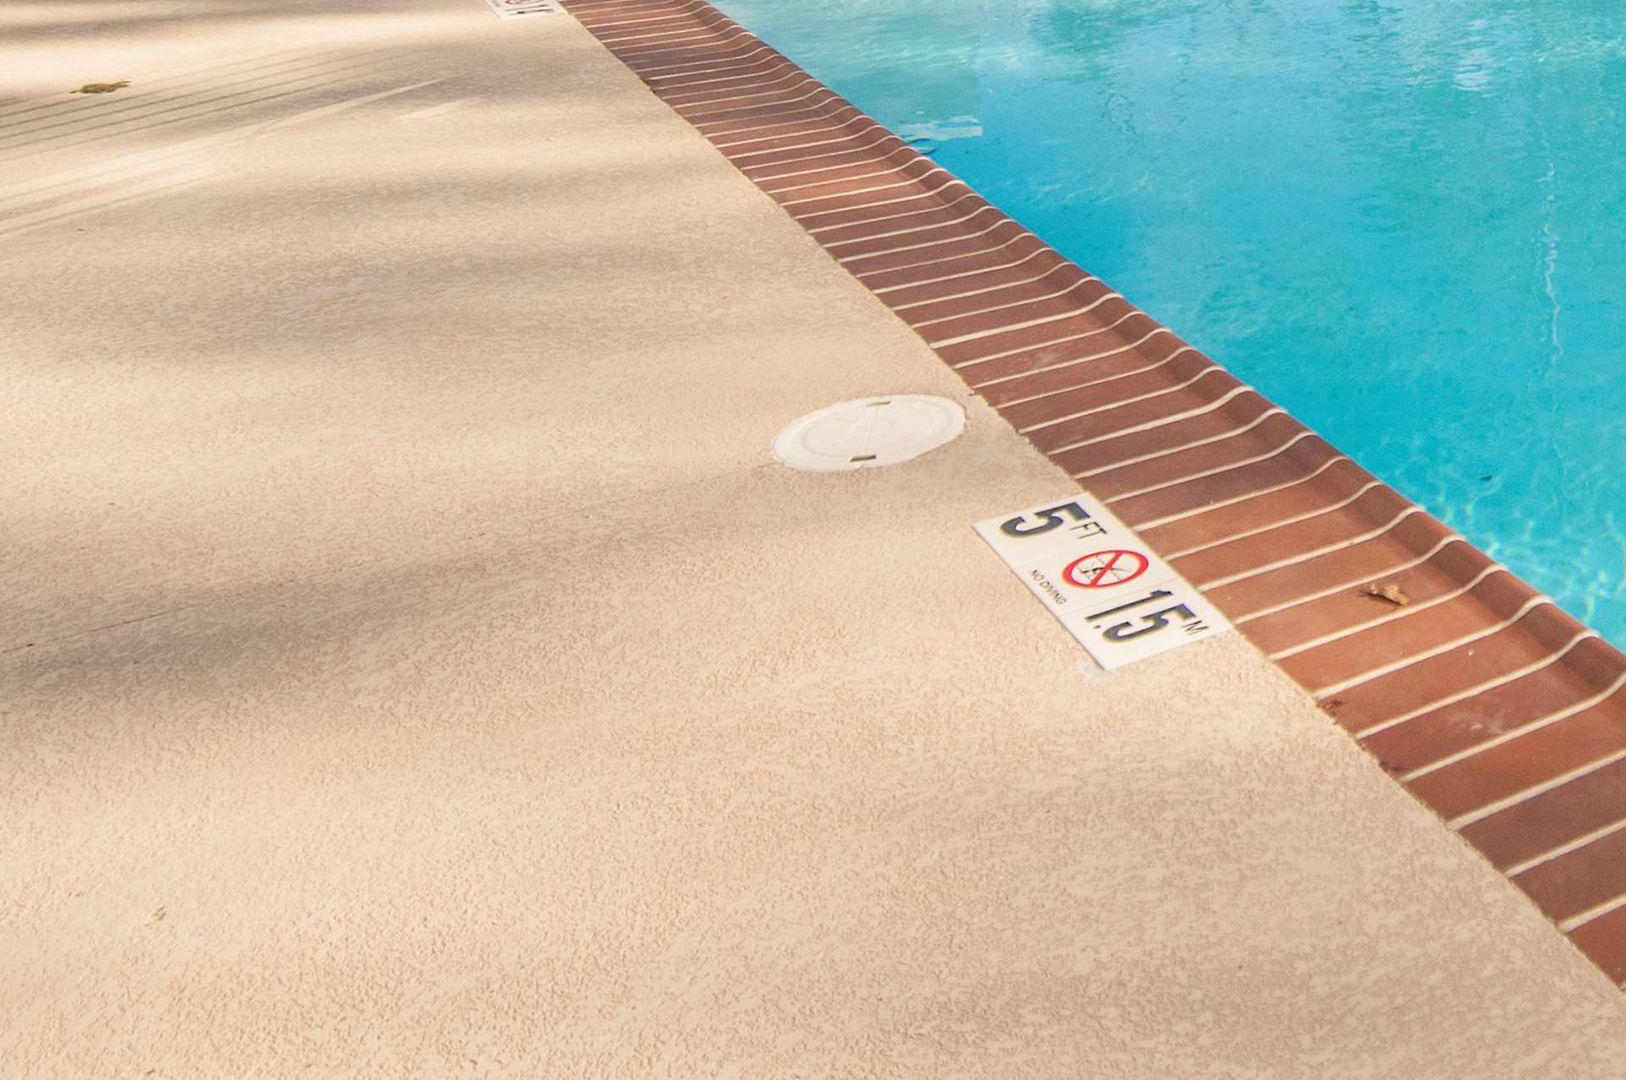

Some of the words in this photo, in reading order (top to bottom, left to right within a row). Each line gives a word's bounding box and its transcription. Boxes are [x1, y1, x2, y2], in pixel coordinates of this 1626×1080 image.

[1000, 502, 1091, 539] 5
[1068, 521, 1108, 540] FT
[1030, 569, 1045, 581] NO
[1039, 580, 1067, 605] DIVING
